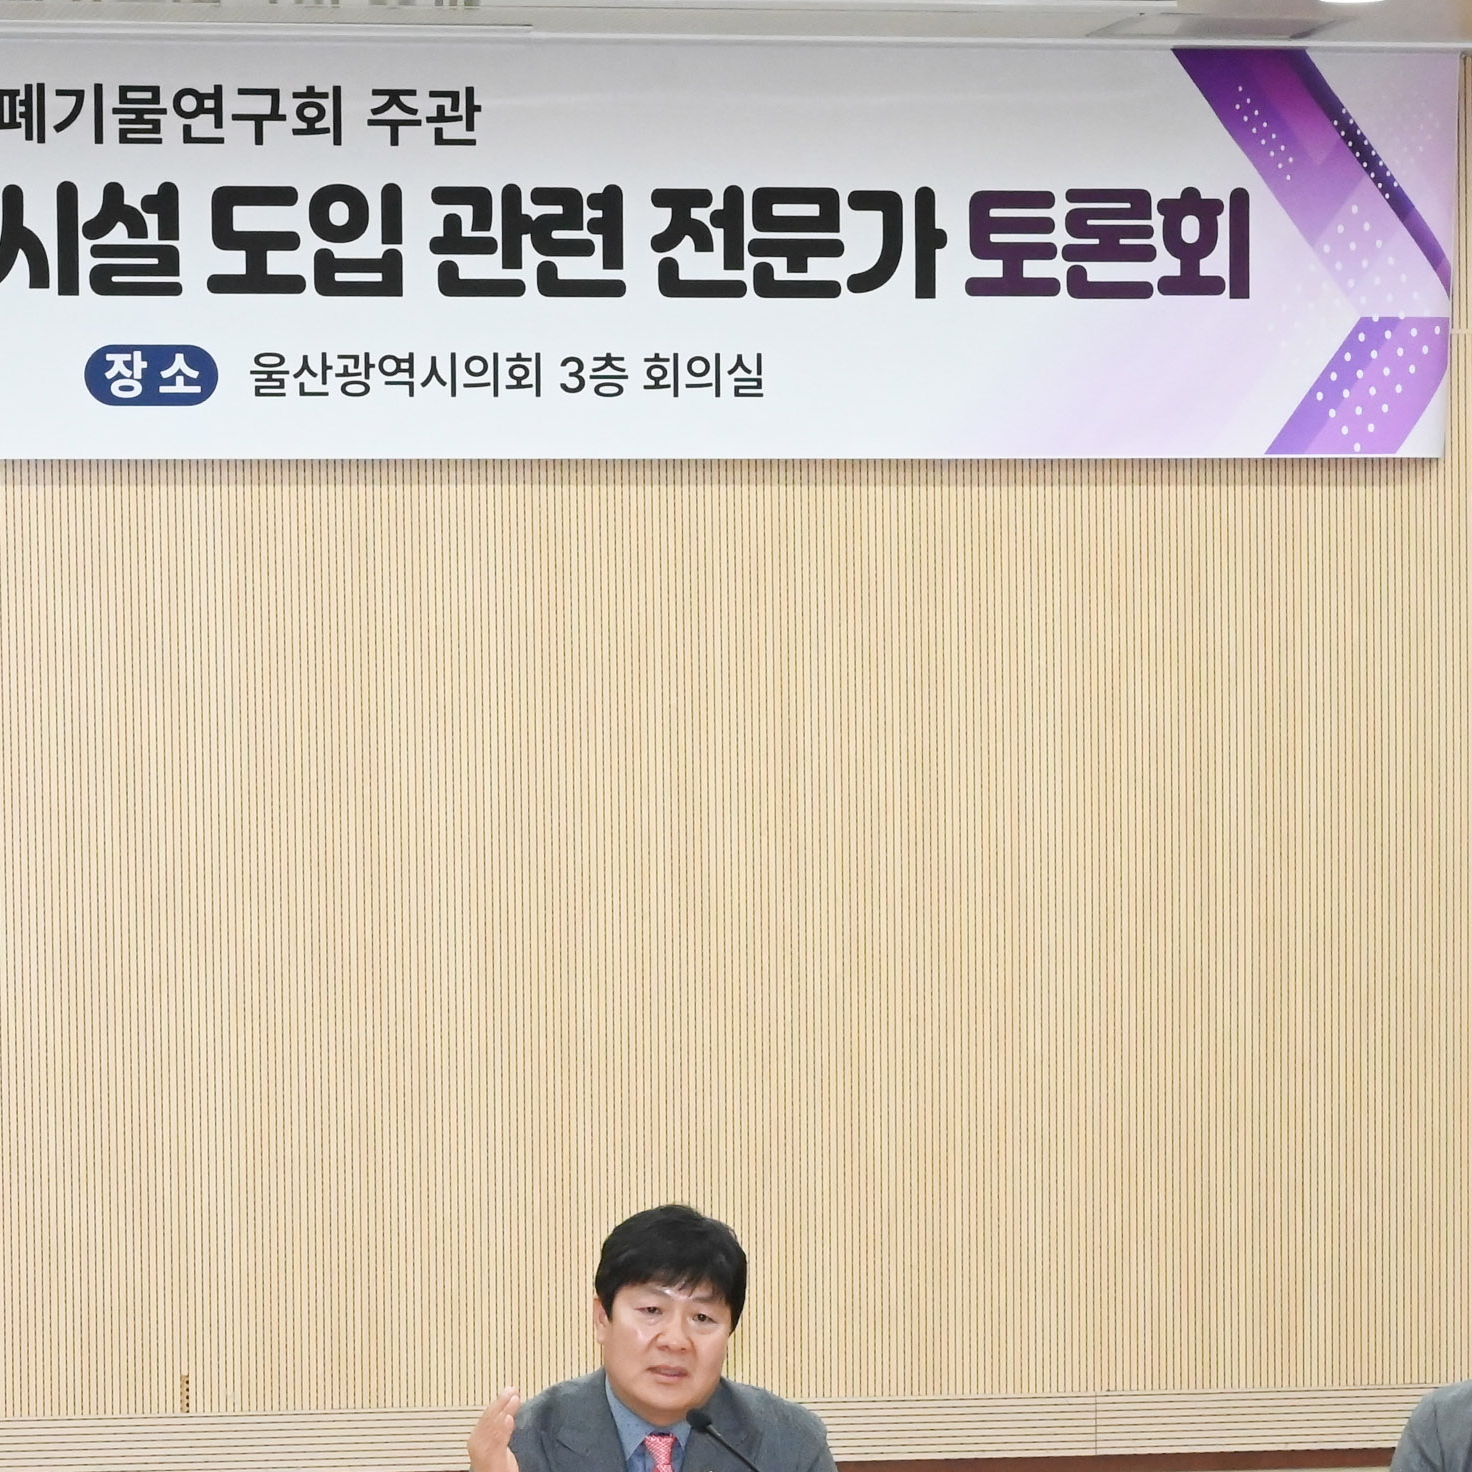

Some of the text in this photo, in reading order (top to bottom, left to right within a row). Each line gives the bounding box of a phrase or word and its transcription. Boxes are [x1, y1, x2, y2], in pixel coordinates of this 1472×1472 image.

[367, 86, 481, 146] 주관
[207, 183, 403, 297] 도입
[430, 184, 626, 297] 관련
[651, 185, 947, 299] 전문가
[965, 187, 1249, 299] 토론회
[250, 352, 763, 397] 울산광역시의회 3층 회의실
